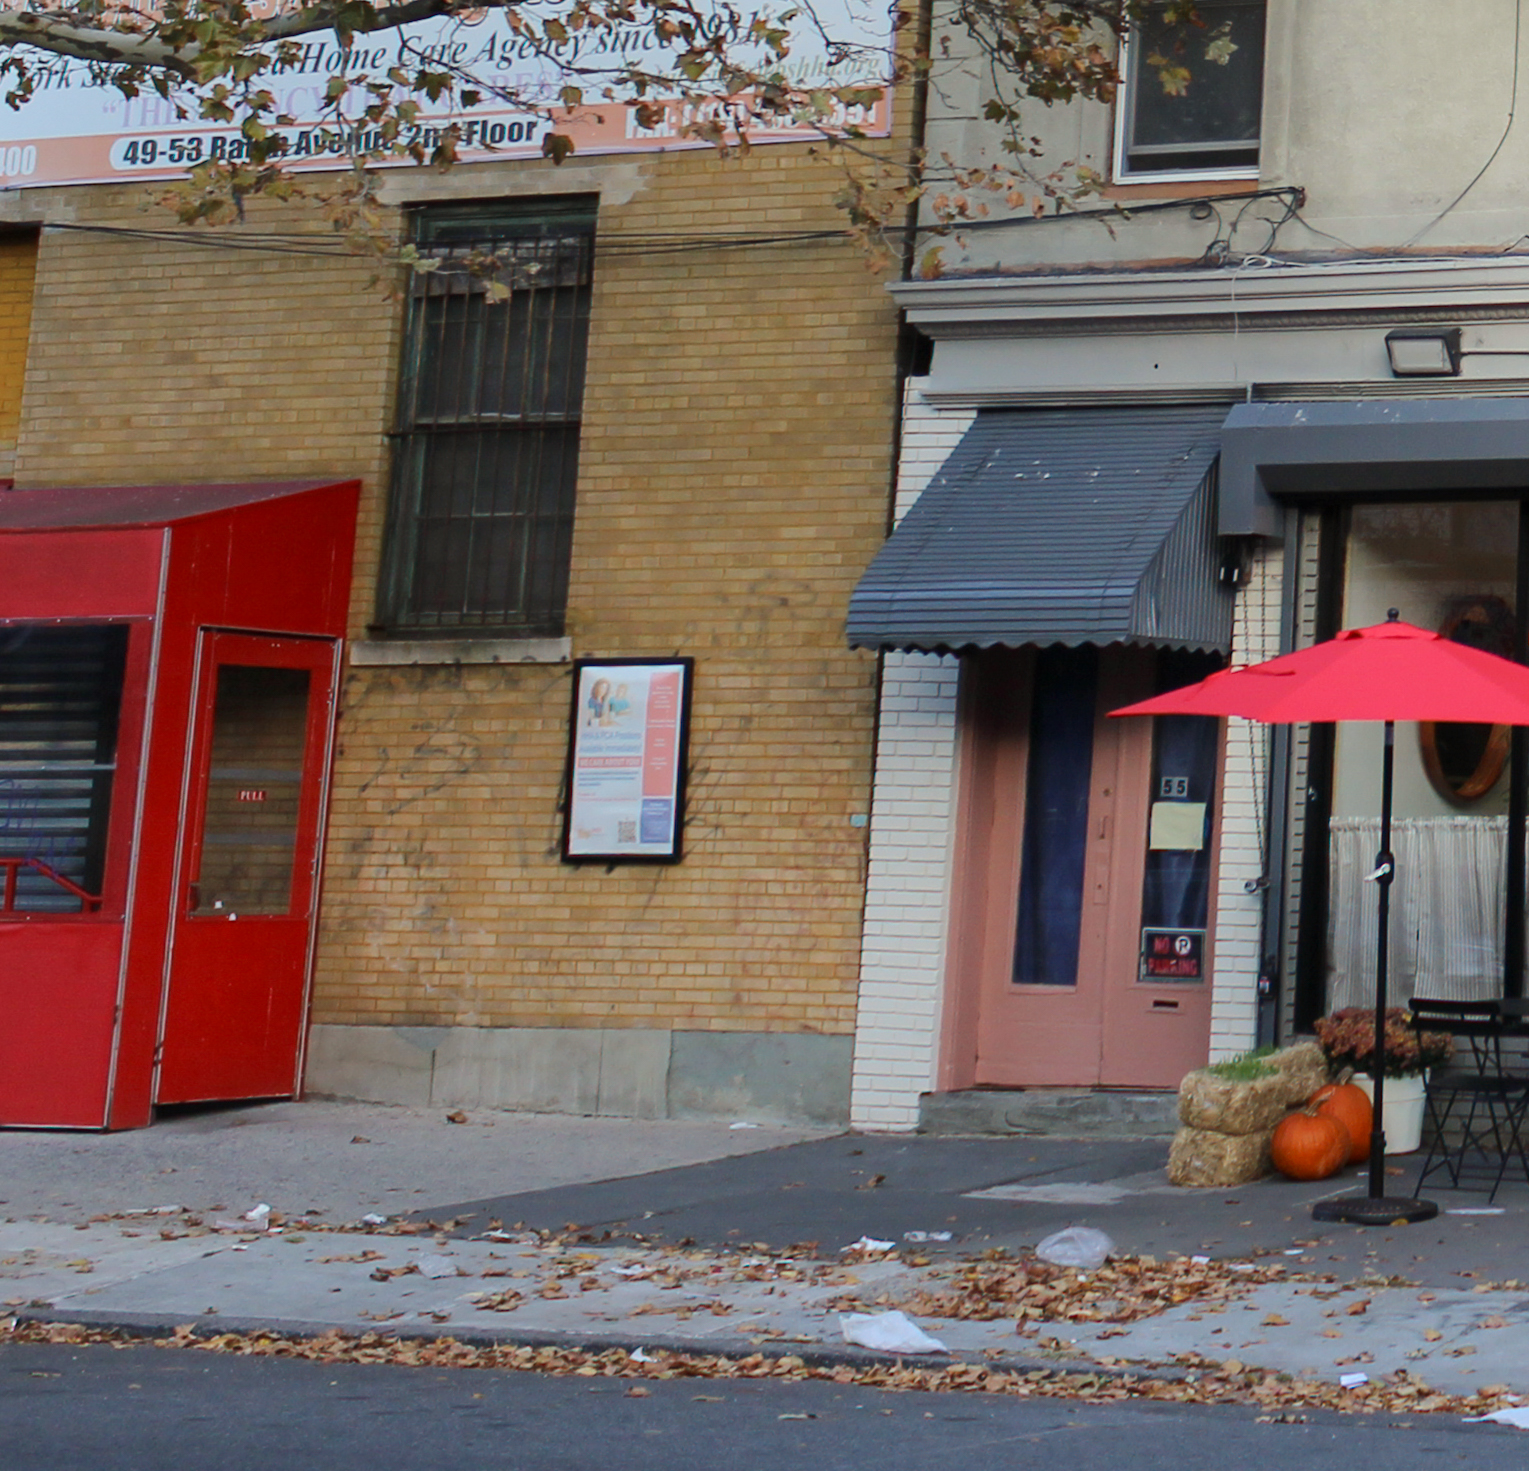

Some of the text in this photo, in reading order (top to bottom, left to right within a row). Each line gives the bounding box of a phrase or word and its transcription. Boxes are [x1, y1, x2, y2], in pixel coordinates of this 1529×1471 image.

[300, 41, 386, 75] Home
[398, 35, 468, 66] Care
[478, 29, 588, 71] Agency
[122, 135, 203, 166] 49-53
[466, 118, 538, 146] Floor
[241, 790, 264, 801] PULL
[1154, 937, 1171, 954] NO
